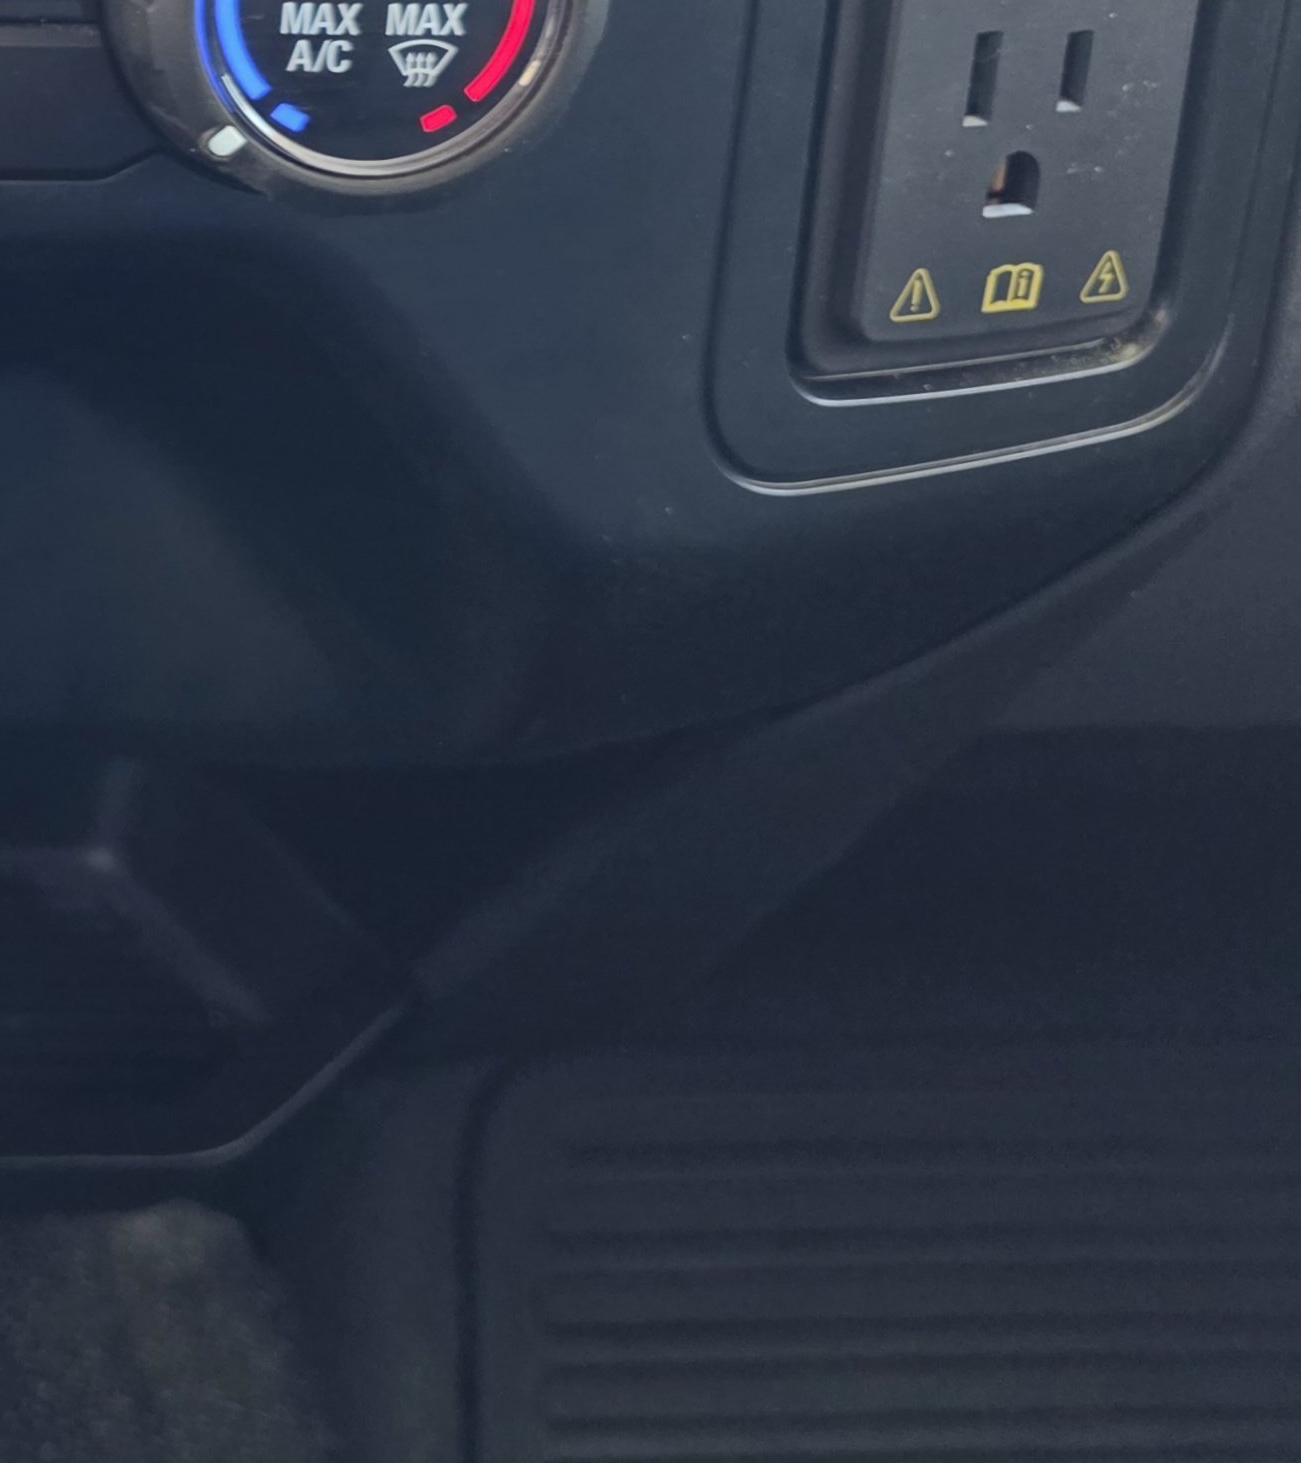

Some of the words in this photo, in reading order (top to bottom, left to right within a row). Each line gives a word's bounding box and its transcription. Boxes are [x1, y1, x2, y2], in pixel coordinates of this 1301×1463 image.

[279, 0, 361, 37] MAX
[384, 1, 467, 38] MAX
[285, 38, 354, 74] A/C
